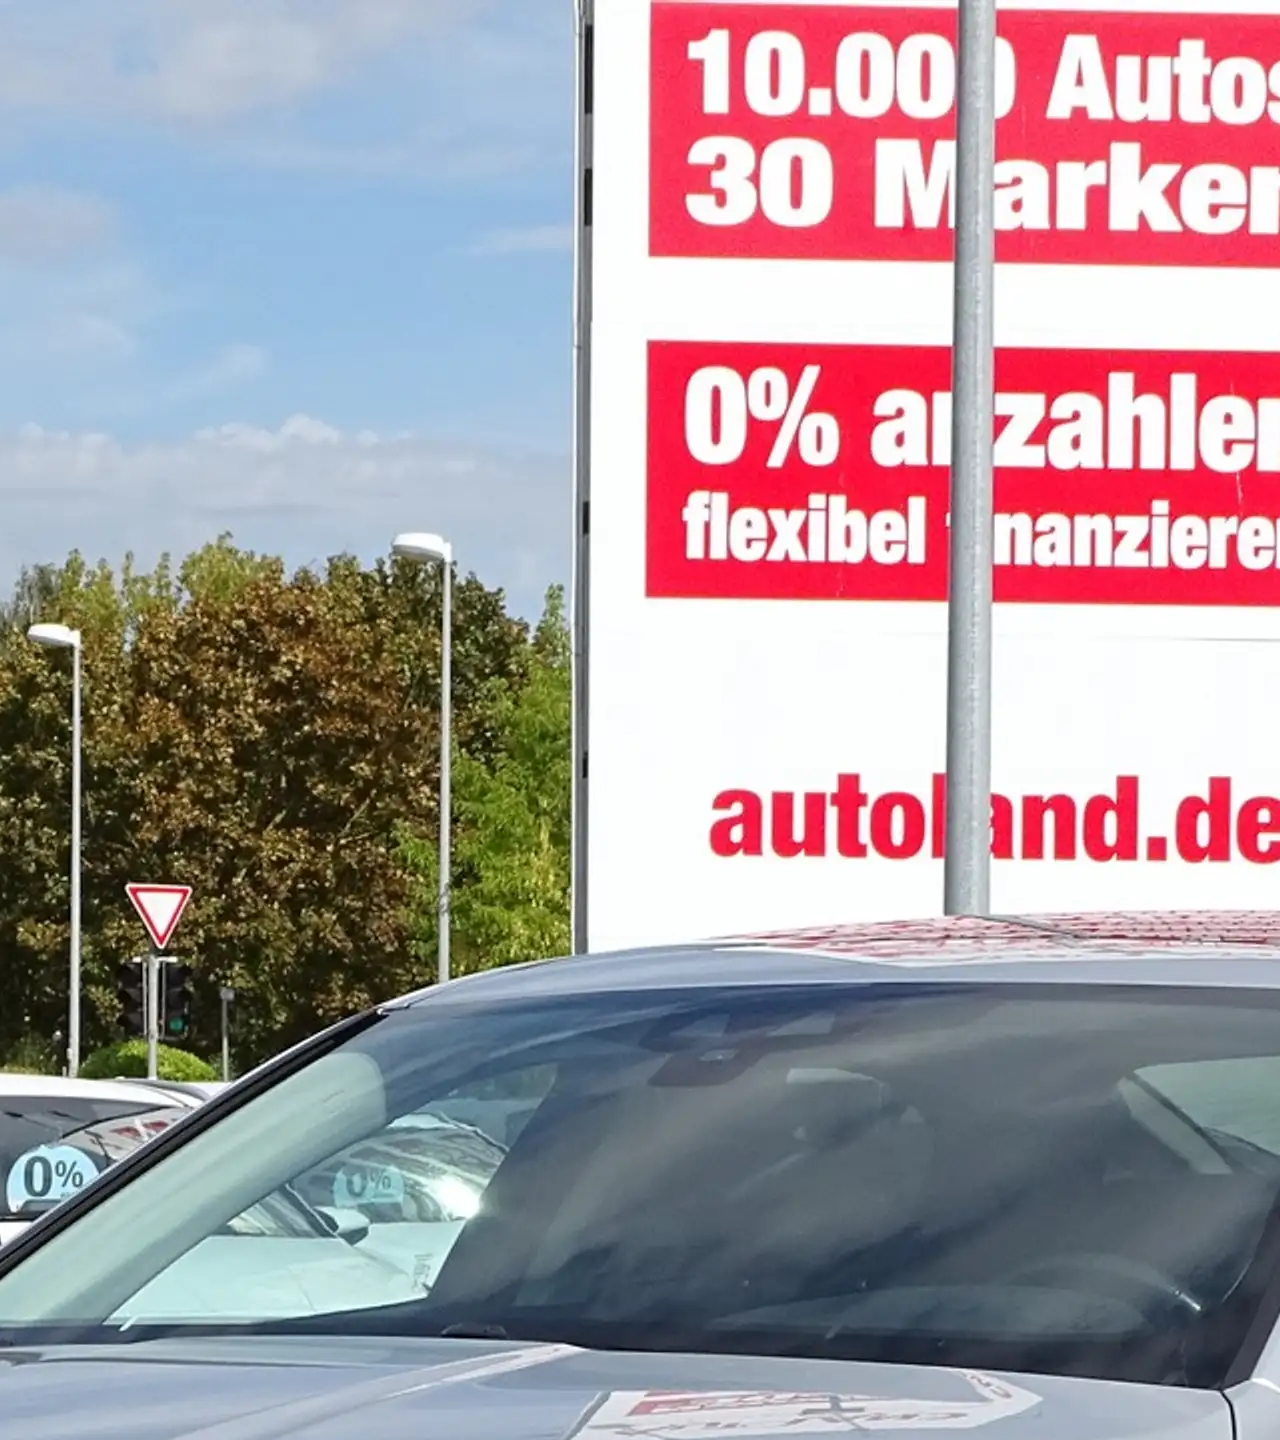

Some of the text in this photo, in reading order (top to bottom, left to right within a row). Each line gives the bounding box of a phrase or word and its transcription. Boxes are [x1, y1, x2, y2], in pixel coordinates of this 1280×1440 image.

[685, 136, 834, 228] 30
[685, 365, 840, 468] 0%
[683, 491, 926, 564] flexibel
[24, 1156, 83, 1197] 0%
